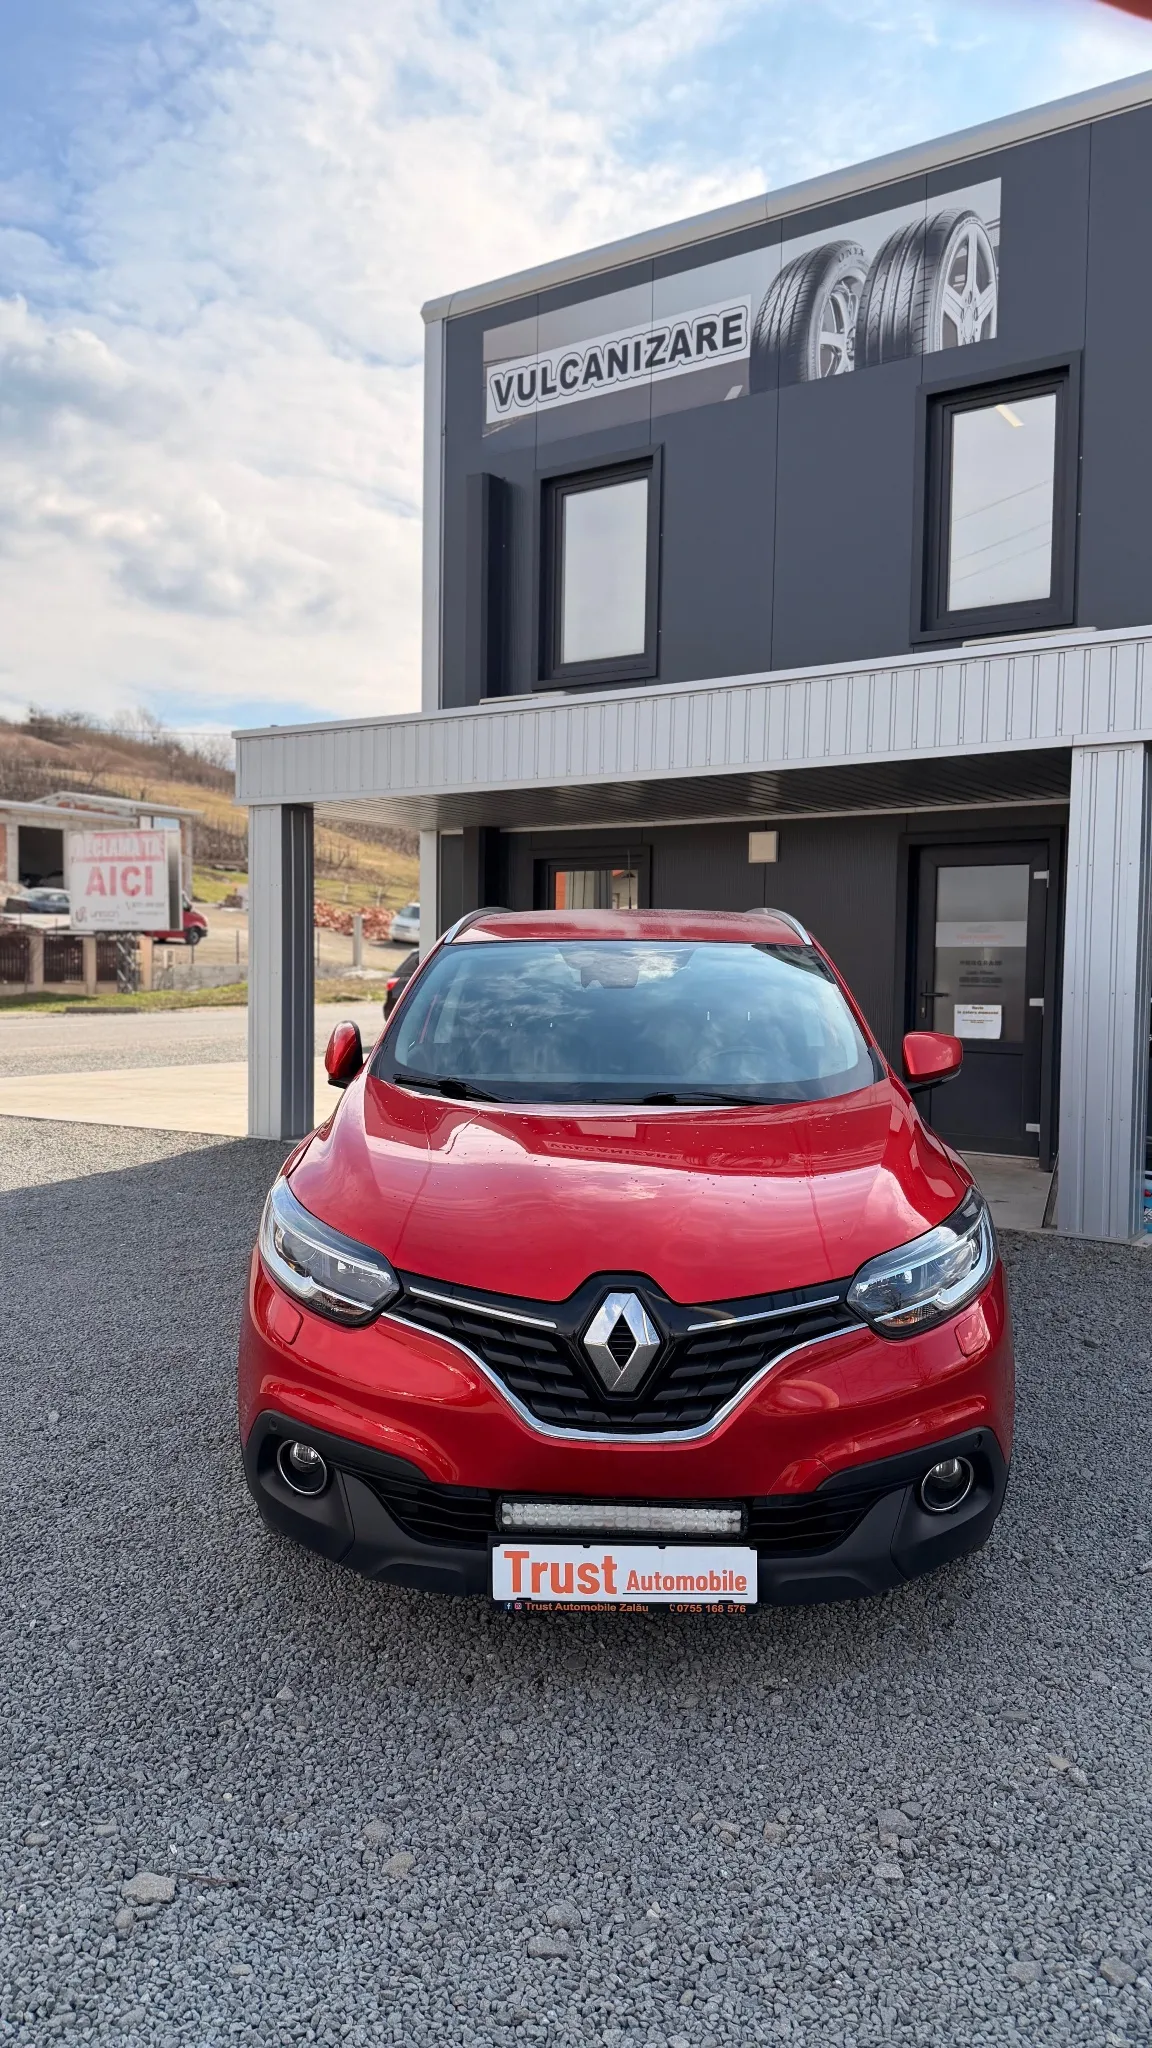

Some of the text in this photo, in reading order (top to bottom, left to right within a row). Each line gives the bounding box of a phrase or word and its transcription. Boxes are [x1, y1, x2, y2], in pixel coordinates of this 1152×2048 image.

[493, 312, 744, 407] VULCANIZARE
[85, 865, 154, 897] AICI
[504, 1550, 747, 1595] Trust Automobile
[524, 1602, 747, 1613] Trust Automobile Zalău 0755 168 576
